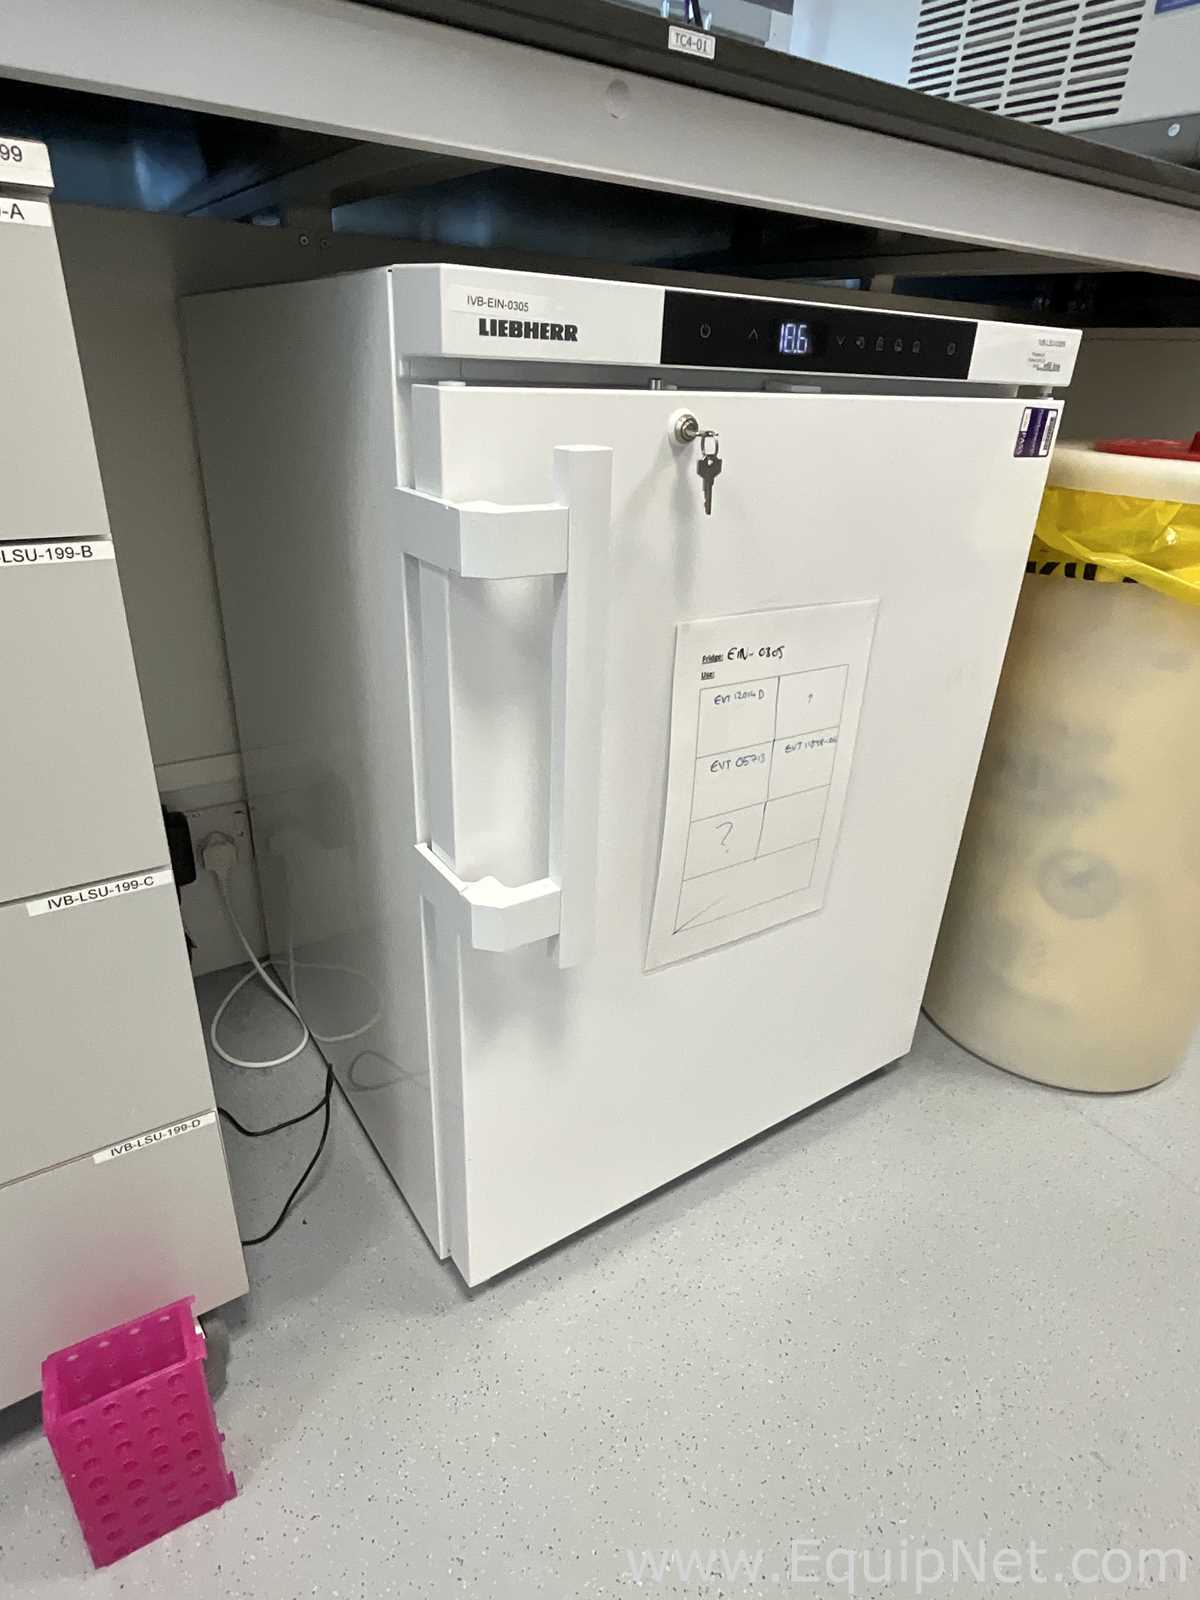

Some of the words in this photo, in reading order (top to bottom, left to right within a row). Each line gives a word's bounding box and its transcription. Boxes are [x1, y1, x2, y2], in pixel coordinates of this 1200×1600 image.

[674, 31, 708, 53] TC4-01
[466, 295, 530, 313] IVB-EIN-0305
[478, 317, 579, 342] LIEBHERR
[0, 544, 94, 564] LSU-199-B
[709, 759, 732, 774] EVT
[715, 821, 734, 854] ?
[47, 875, 155, 910] IVB-LSU-199-C
[110, 1118, 201, 1157] IVB-LSU-199-D
